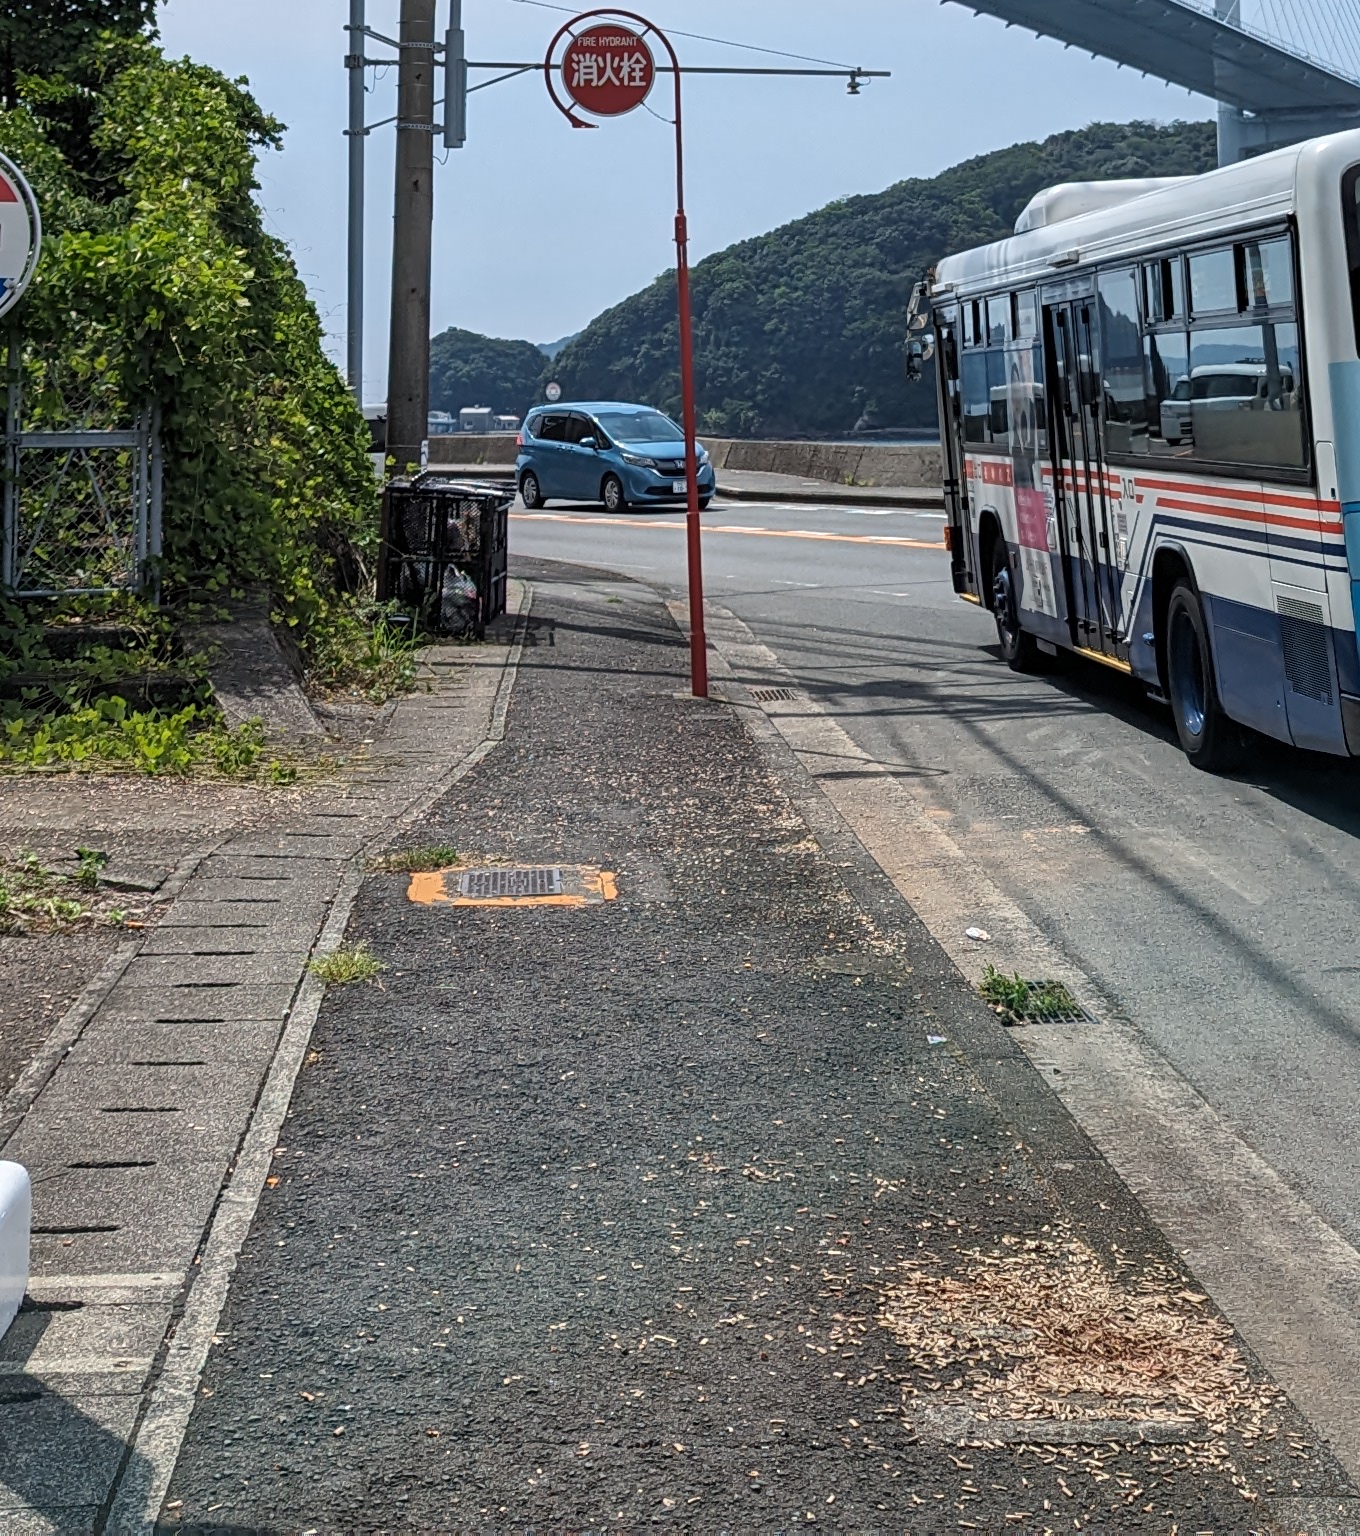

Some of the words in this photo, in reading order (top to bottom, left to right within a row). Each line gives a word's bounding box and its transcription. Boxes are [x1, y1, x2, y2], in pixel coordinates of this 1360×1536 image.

[577, 36, 597, 47] FIRE
[598, 36, 638, 47] HYDRANT
[571, 51, 647, 87] 消火栓
